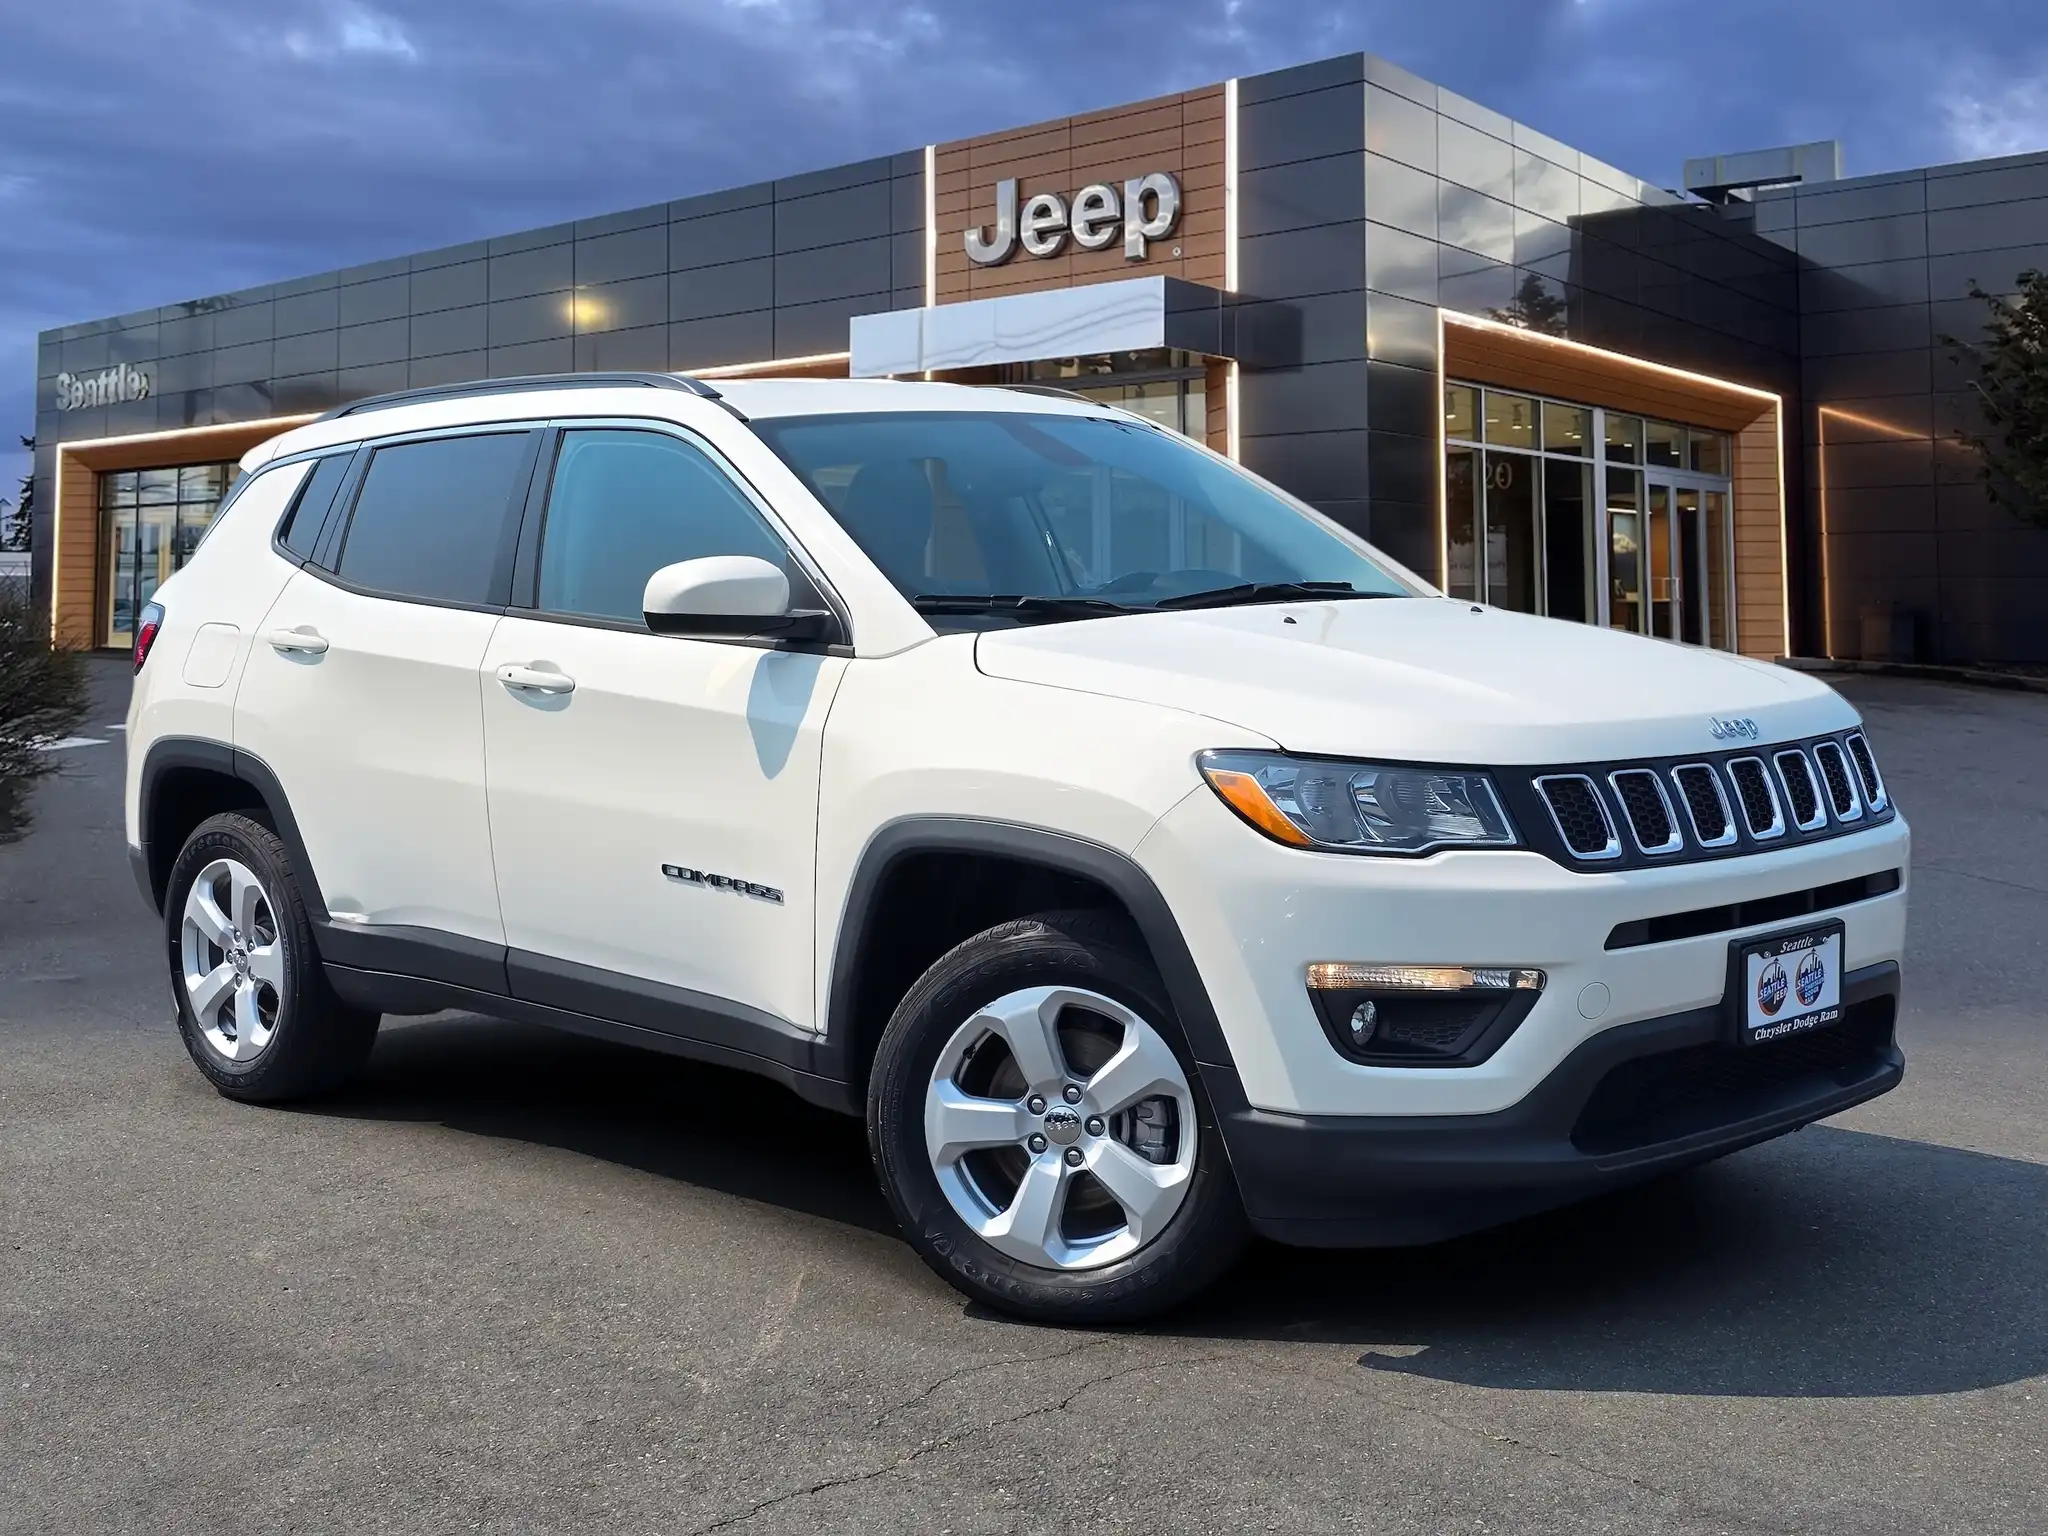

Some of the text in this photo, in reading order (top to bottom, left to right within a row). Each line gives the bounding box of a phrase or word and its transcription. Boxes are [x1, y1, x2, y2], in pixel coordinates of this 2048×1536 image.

[964, 172, 1181, 265] Jeep
[56, 362, 146, 411] Seattle
[1708, 716, 1759, 740] Jeep
[661, 863, 784, 903] COMPASS
[1780, 936, 1813, 953] Seattle
[1759, 978, 1785, 1001] SEATTLE
[1796, 968, 1823, 990] SEATTLE
[1755, 1009, 1838, 1041] Chrysler Dodge Ram
